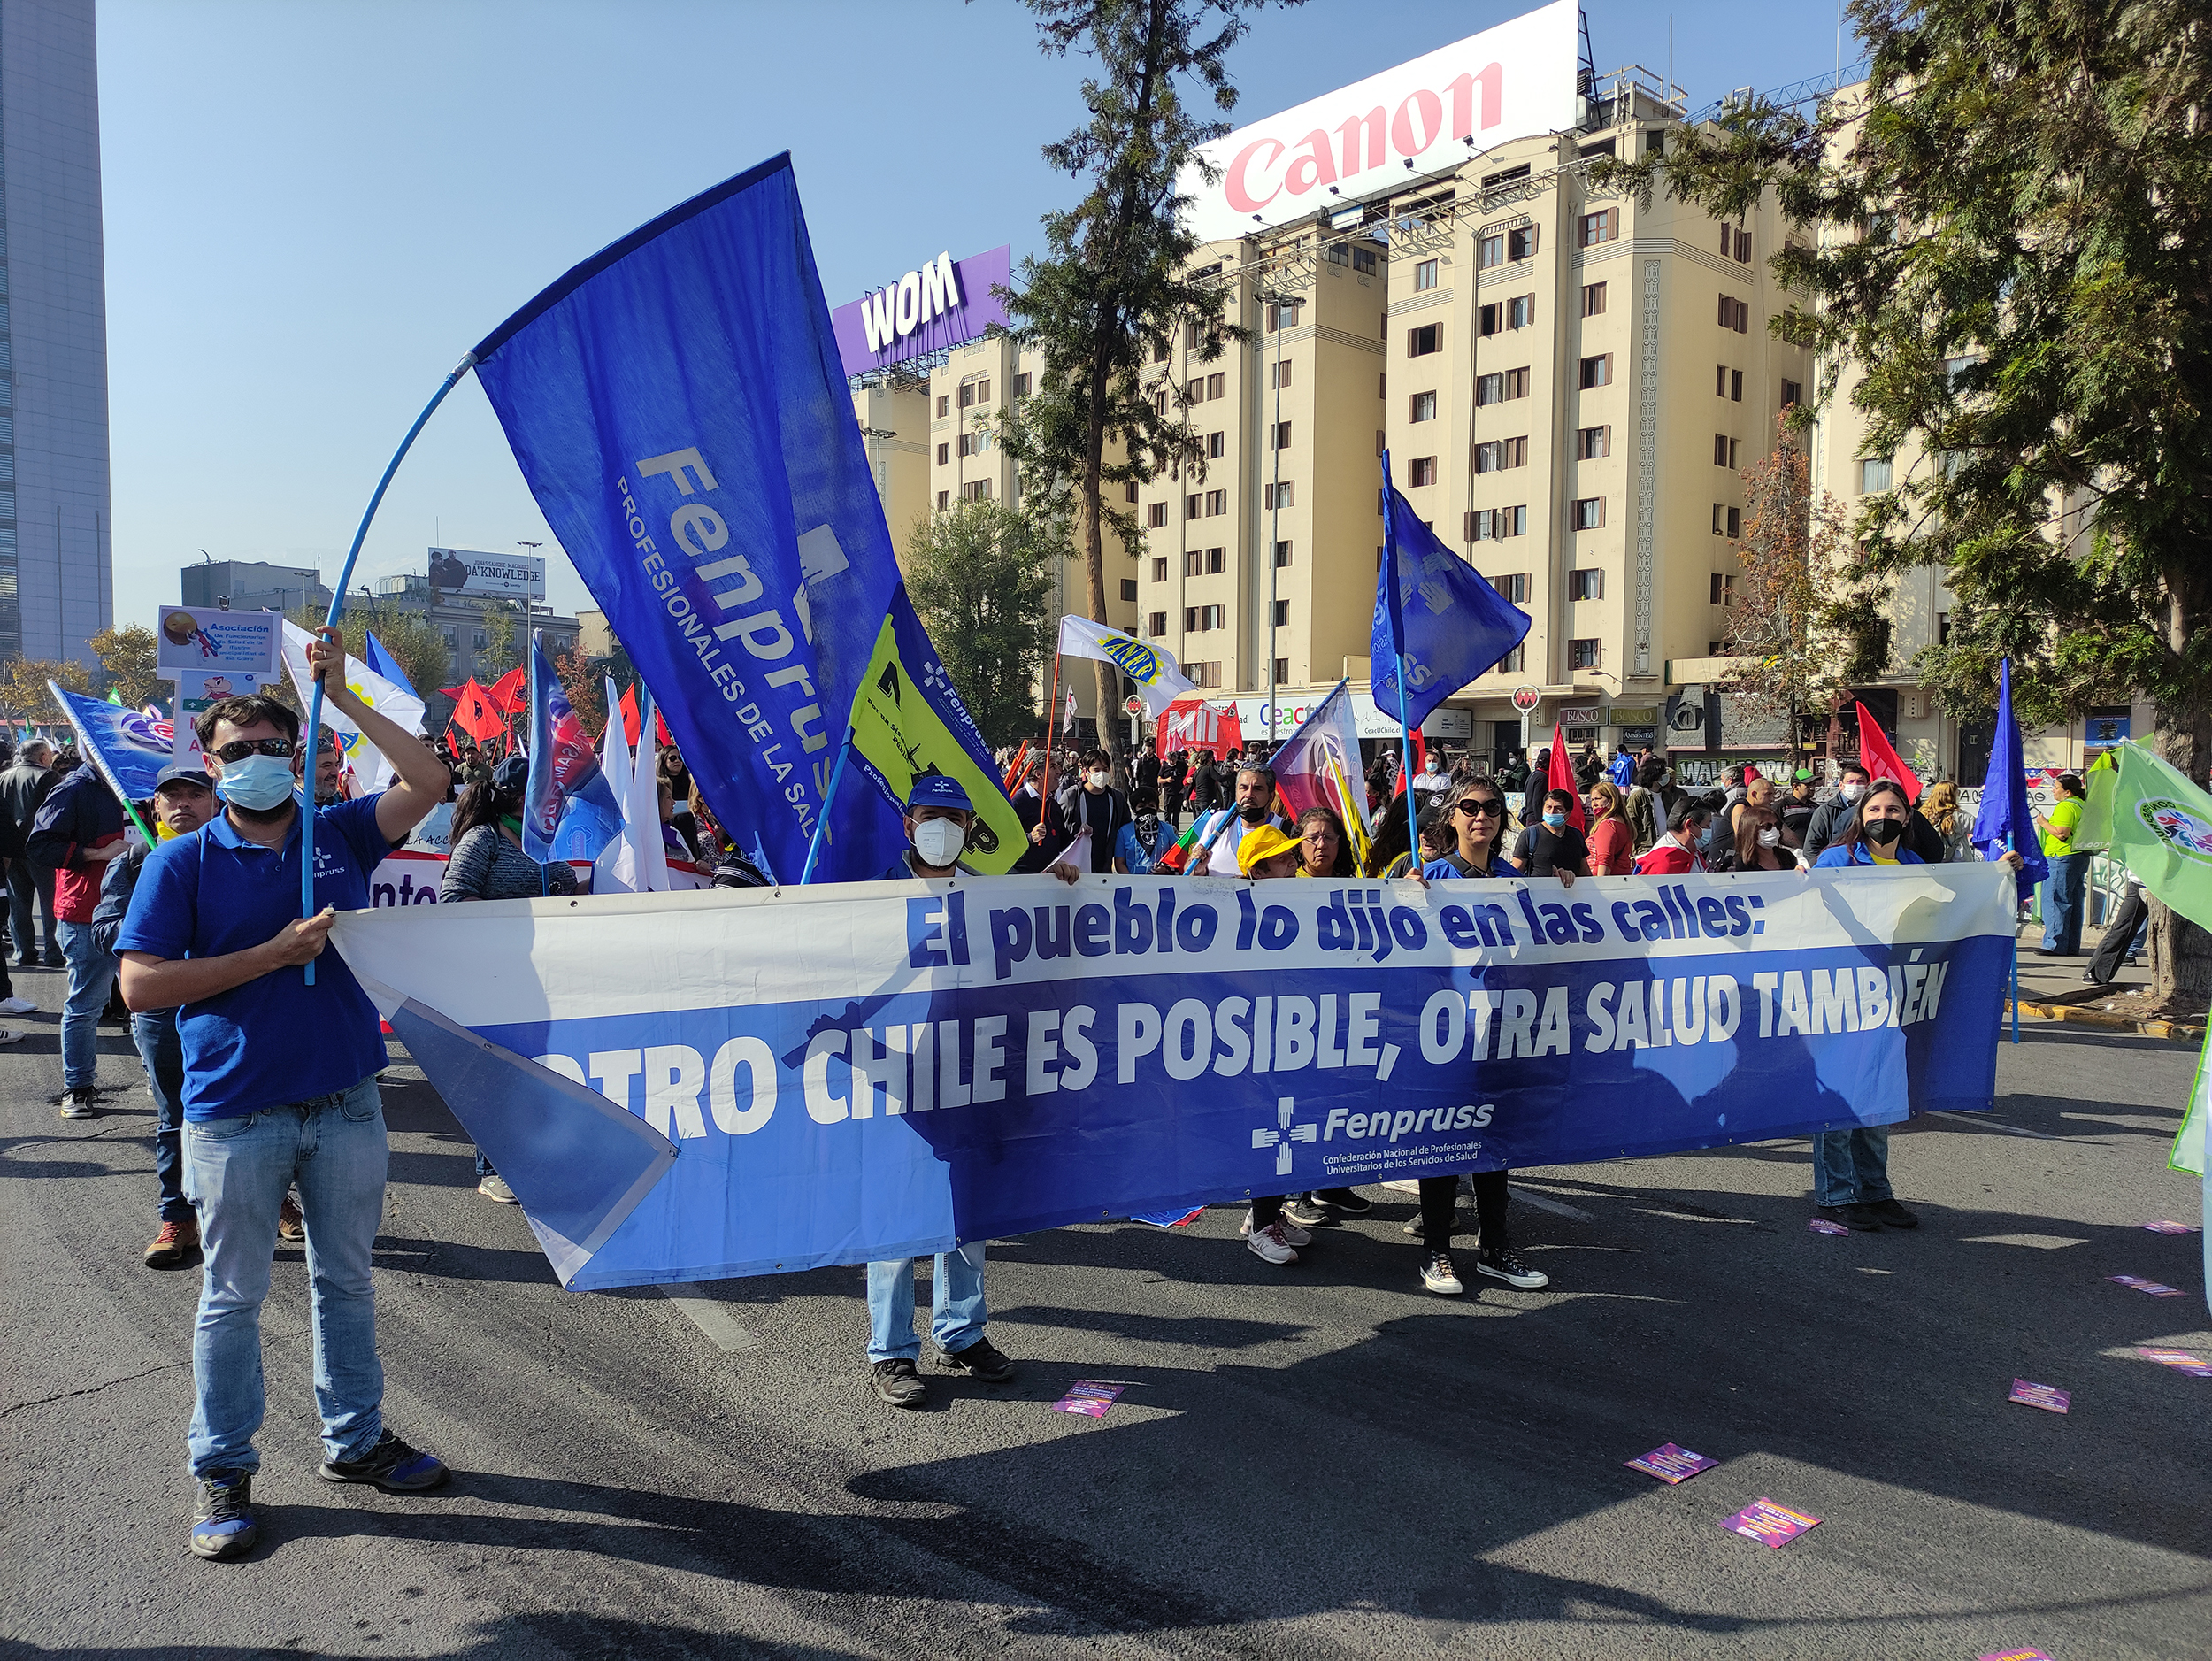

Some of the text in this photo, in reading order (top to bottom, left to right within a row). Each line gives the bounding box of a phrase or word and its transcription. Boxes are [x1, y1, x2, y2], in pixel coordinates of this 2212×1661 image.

[1225, 62, 1502, 213] Canon
[861, 250, 959, 353] WOM
[211, 623, 269, 633] Asociación
[635, 446, 833, 846] Fenprus
[617, 476, 819, 869] PROFESIONALES DE LA SAL
[942, 688, 991, 755] Fenpruss
[1567, 710, 1599, 722] BLASCO
[1616, 710, 1653, 722] BLASCO
[425, 834, 450, 845] ACC
[314, 866, 346, 879] npruss
[906, 883, 1766, 980] El pueblo lo dijo en las calles:
[803, 1013, 1008, 1126] CHILE
[1025, 1004, 1100, 1092] ES
[1116, 991, 1402, 1084] POSIBLE,
[1418, 985, 1571, 1065] OTRA
[1584, 974, 1742, 1054] SALUD
[1753, 947, 1950, 1038] TAMBIÉN
[1322, 1103, 1495, 1143] Fenpruss
[1322, 1140, 1482, 1165] Confederación Nacional de Profesionales
[1326, 1150, 1478, 1175] Universitarios de los Servicios de Salud
